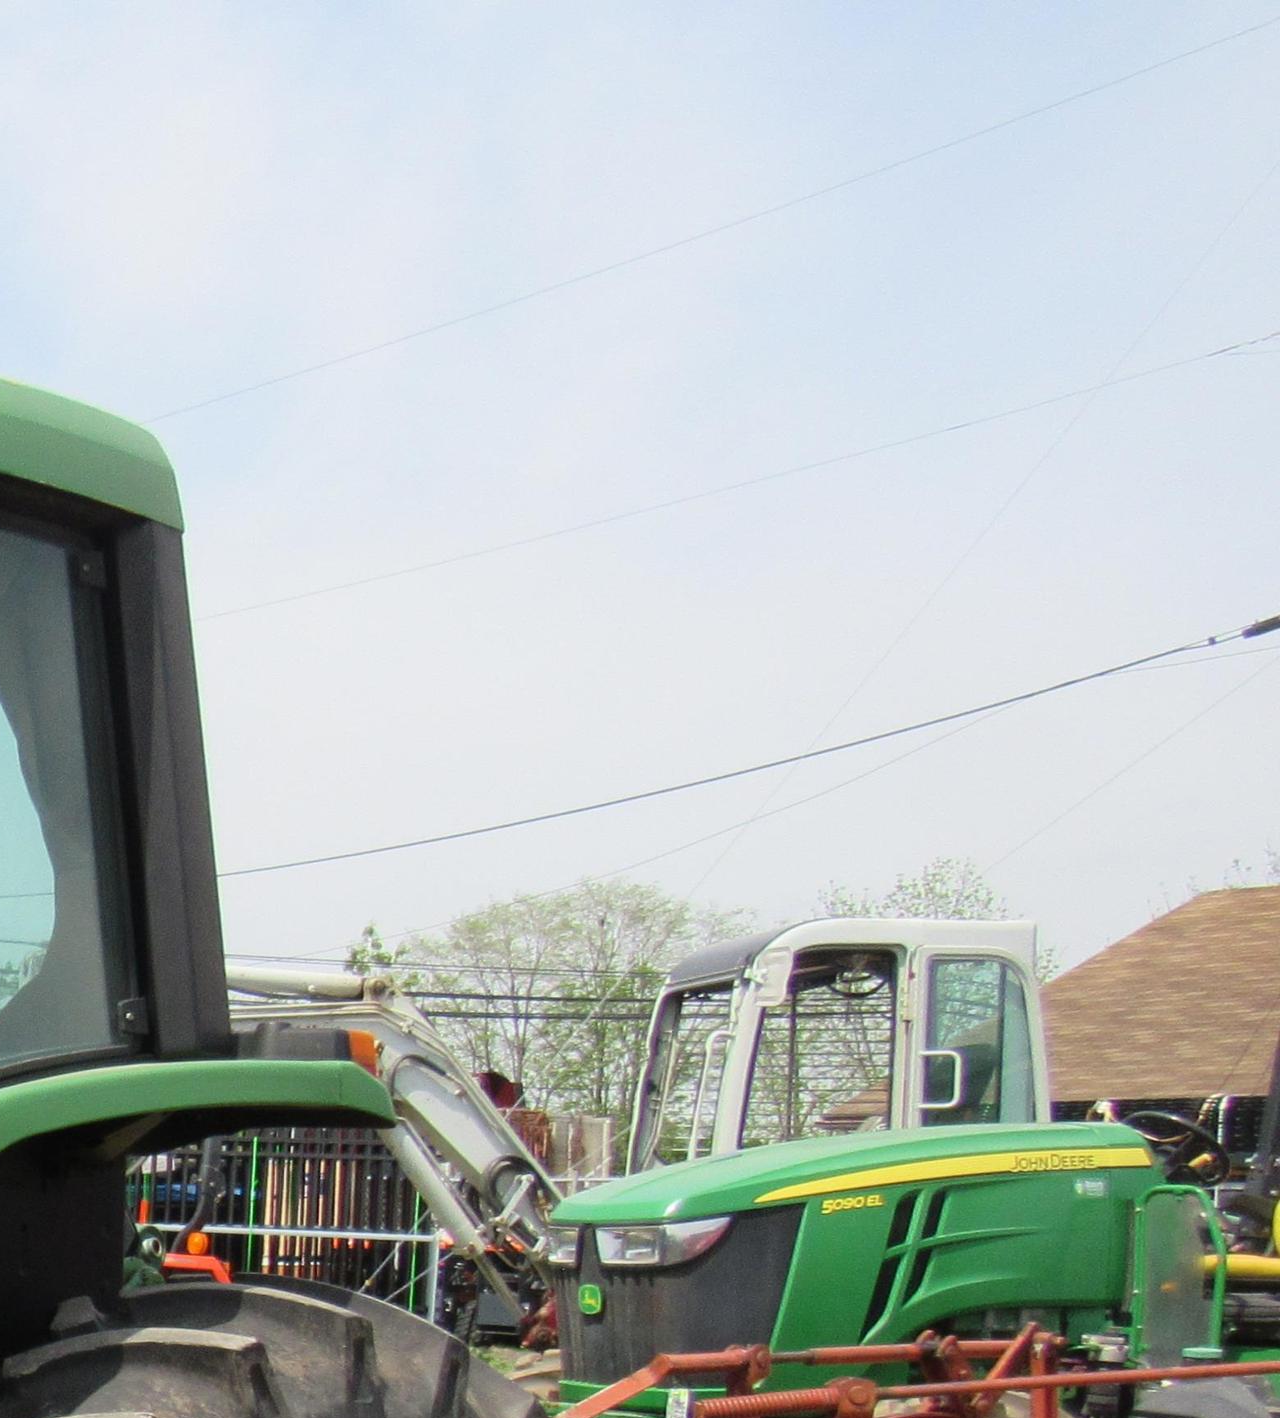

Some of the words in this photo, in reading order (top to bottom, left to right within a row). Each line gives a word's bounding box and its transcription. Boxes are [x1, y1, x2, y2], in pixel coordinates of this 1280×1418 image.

[1009, 1154, 1049, 1171] JOHN
[1050, 1152, 1096, 1169] DEERE
[821, 1196, 865, 1215] 5090
[866, 1194, 884, 1207] EL
